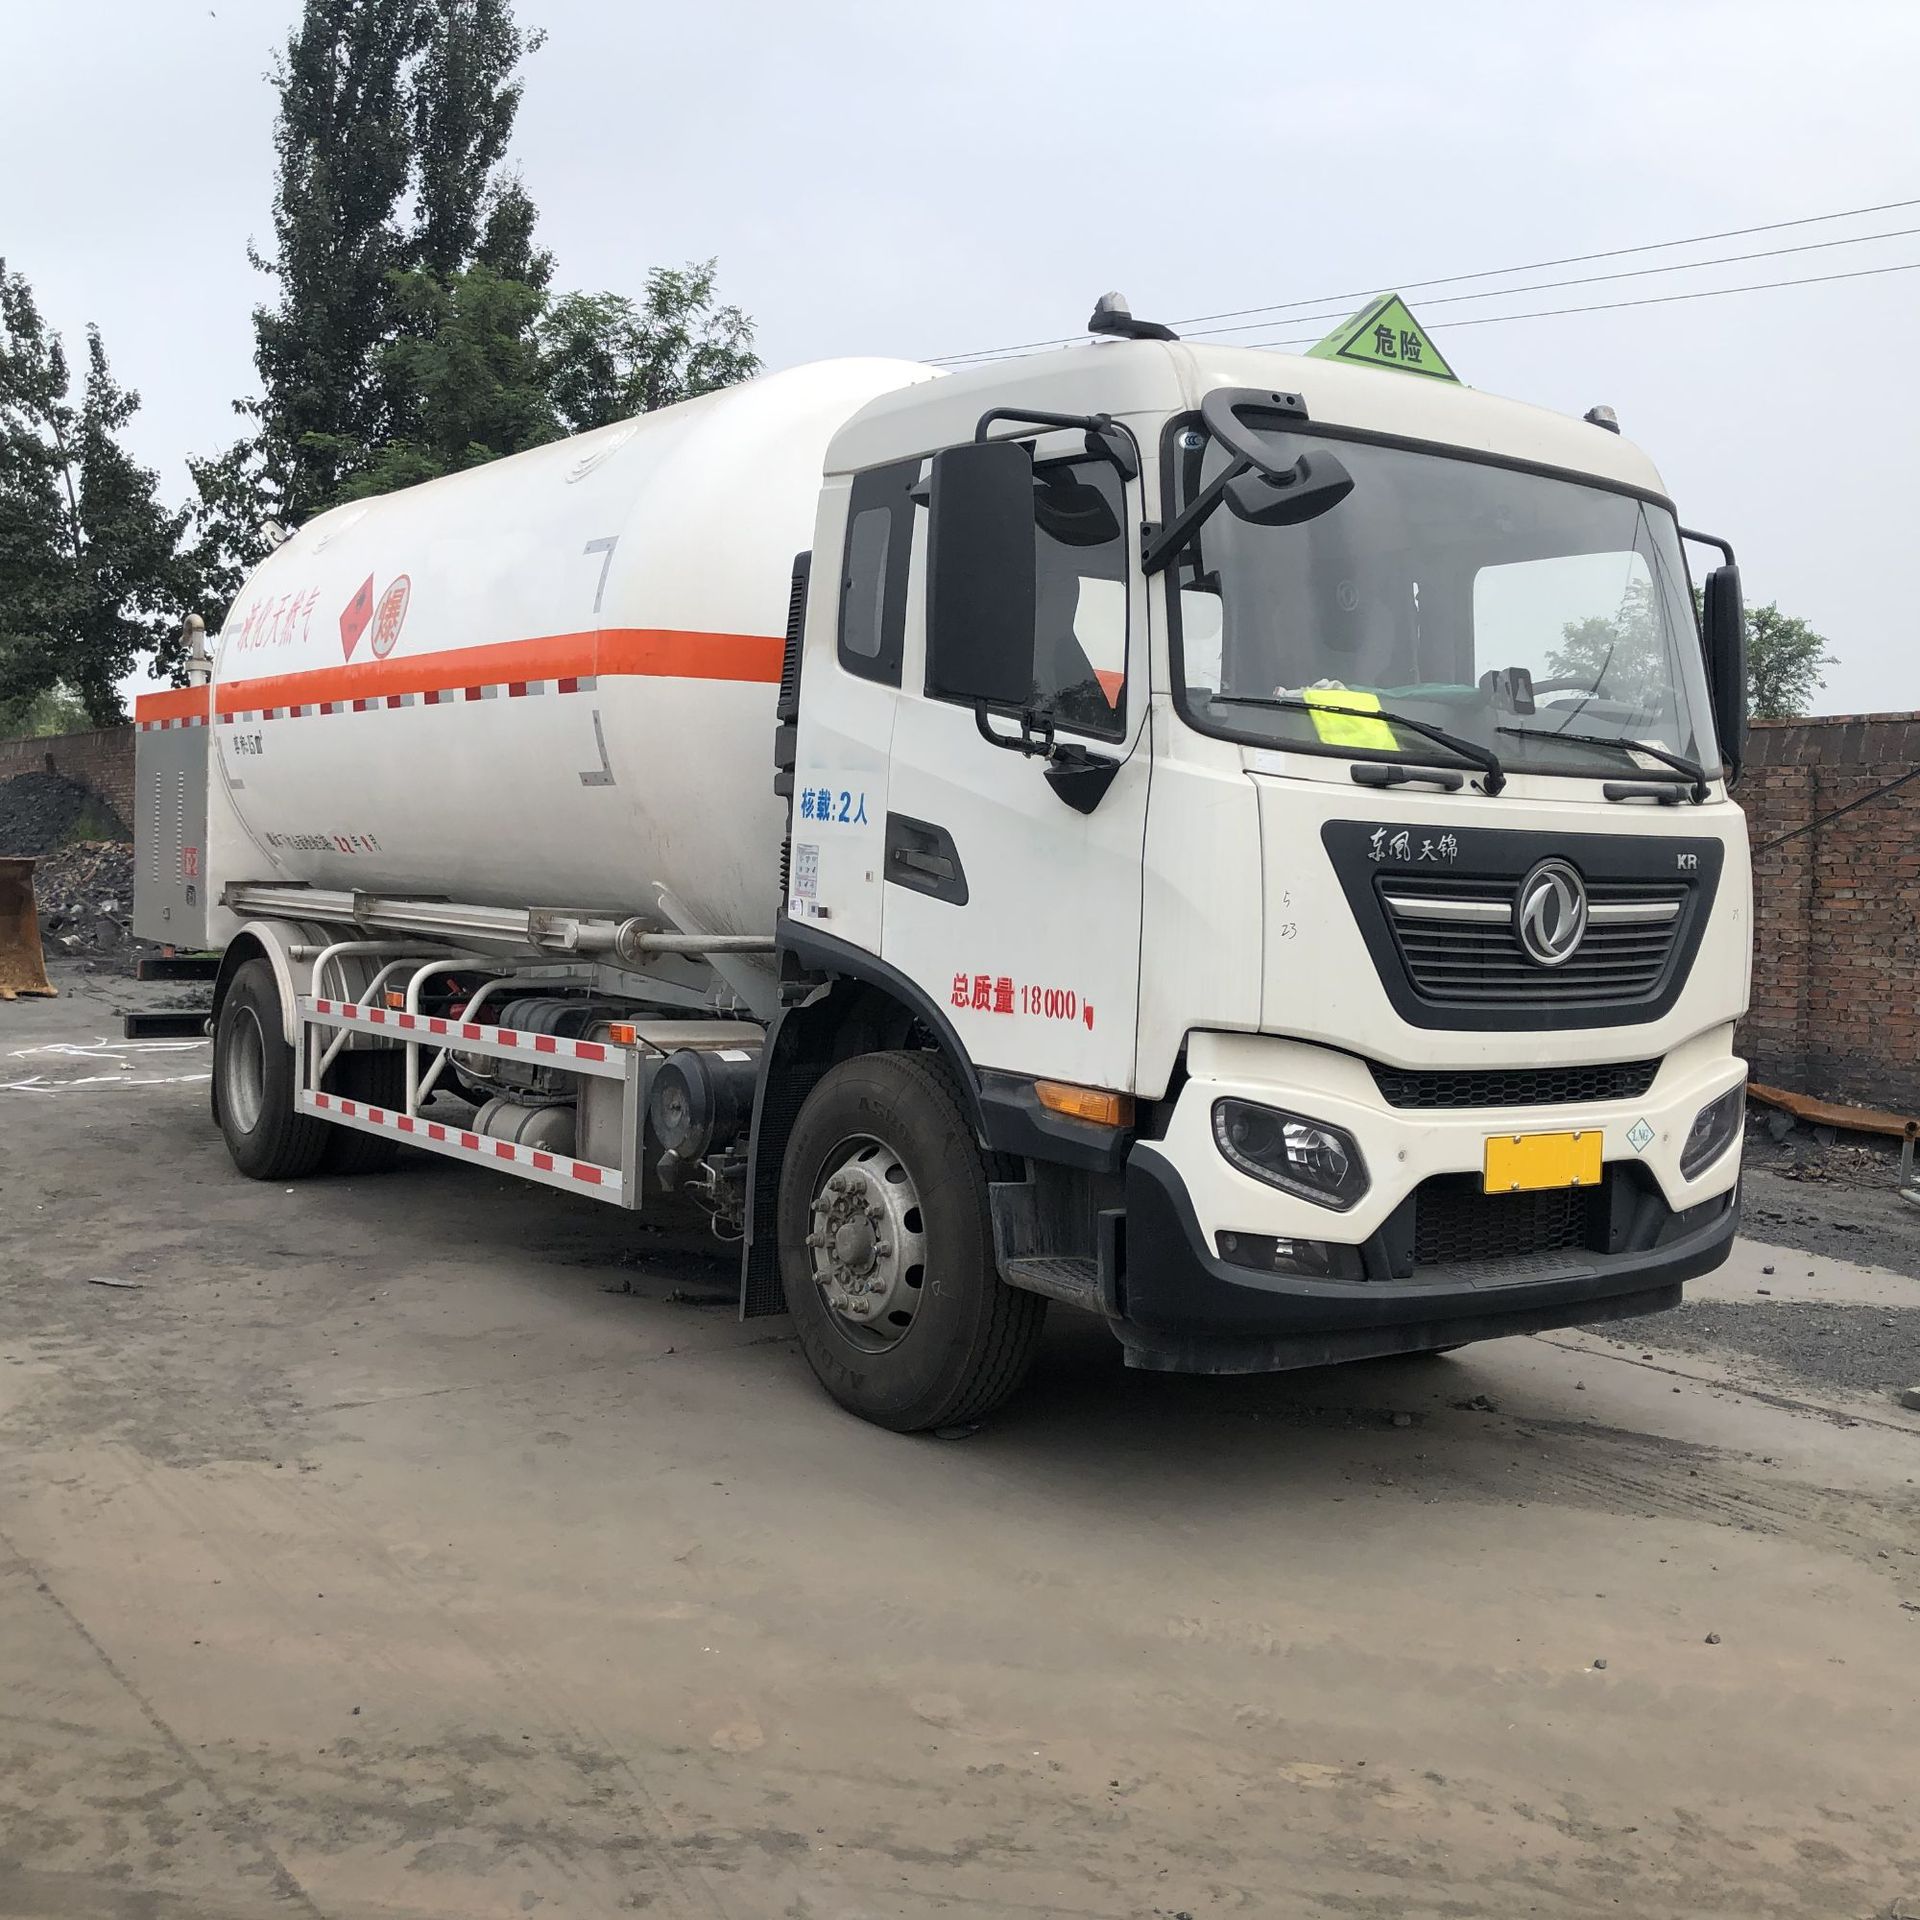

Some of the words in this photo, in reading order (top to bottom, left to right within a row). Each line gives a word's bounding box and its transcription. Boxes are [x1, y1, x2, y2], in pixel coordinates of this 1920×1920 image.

[1373, 323, 1423, 364] 危险
[1677, 853, 1698, 870] KR
[1281, 922, 1297, 940] 23
